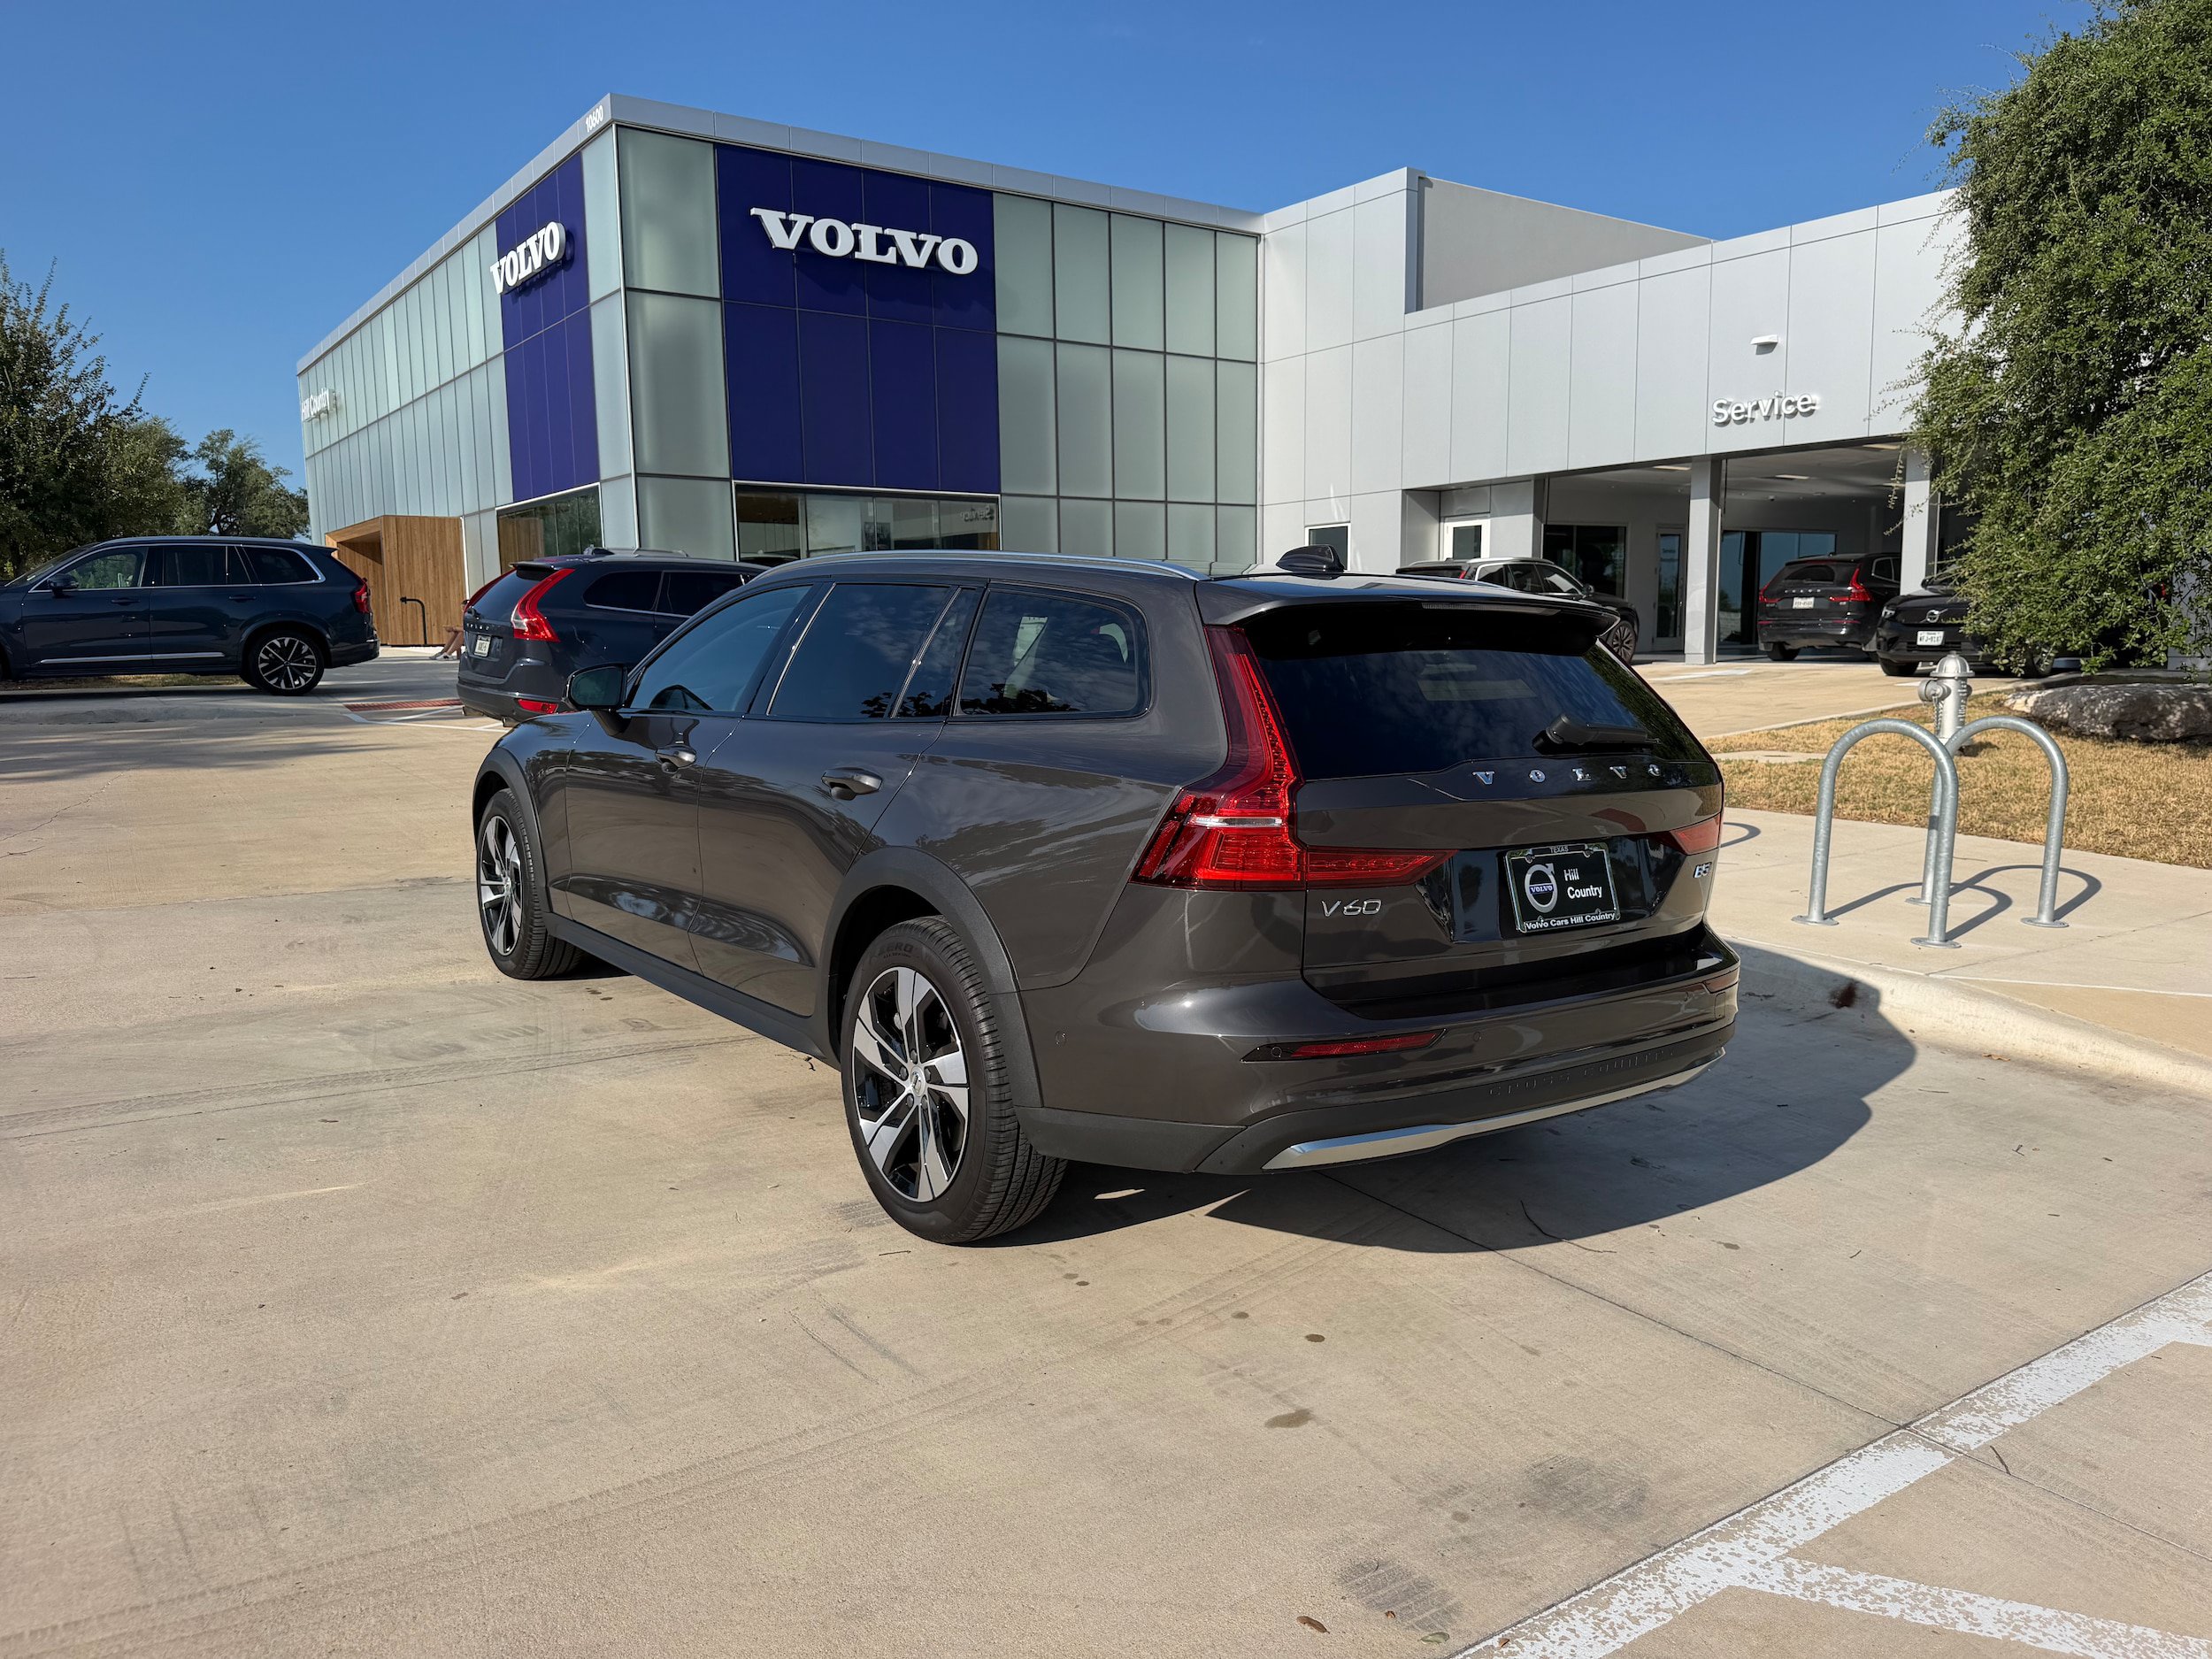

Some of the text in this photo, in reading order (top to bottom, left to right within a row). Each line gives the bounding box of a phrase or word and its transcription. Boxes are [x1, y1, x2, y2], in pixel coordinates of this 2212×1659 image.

[585, 104, 603, 133] 10600
[750, 207, 978, 275] VOLVO
[490, 221, 563, 295] VOLVO
[1711, 390, 1814, 424] Service
[1472, 764, 1661, 785] VOLVO
[1563, 868, 1579, 881] Hill
[1530, 885, 1554, 894] VOLVO
[1567, 885, 1602, 899] Country
[1321, 899, 1381, 917] V60
[1525, 912, 1616, 930] Volvo Cars Hill Country
